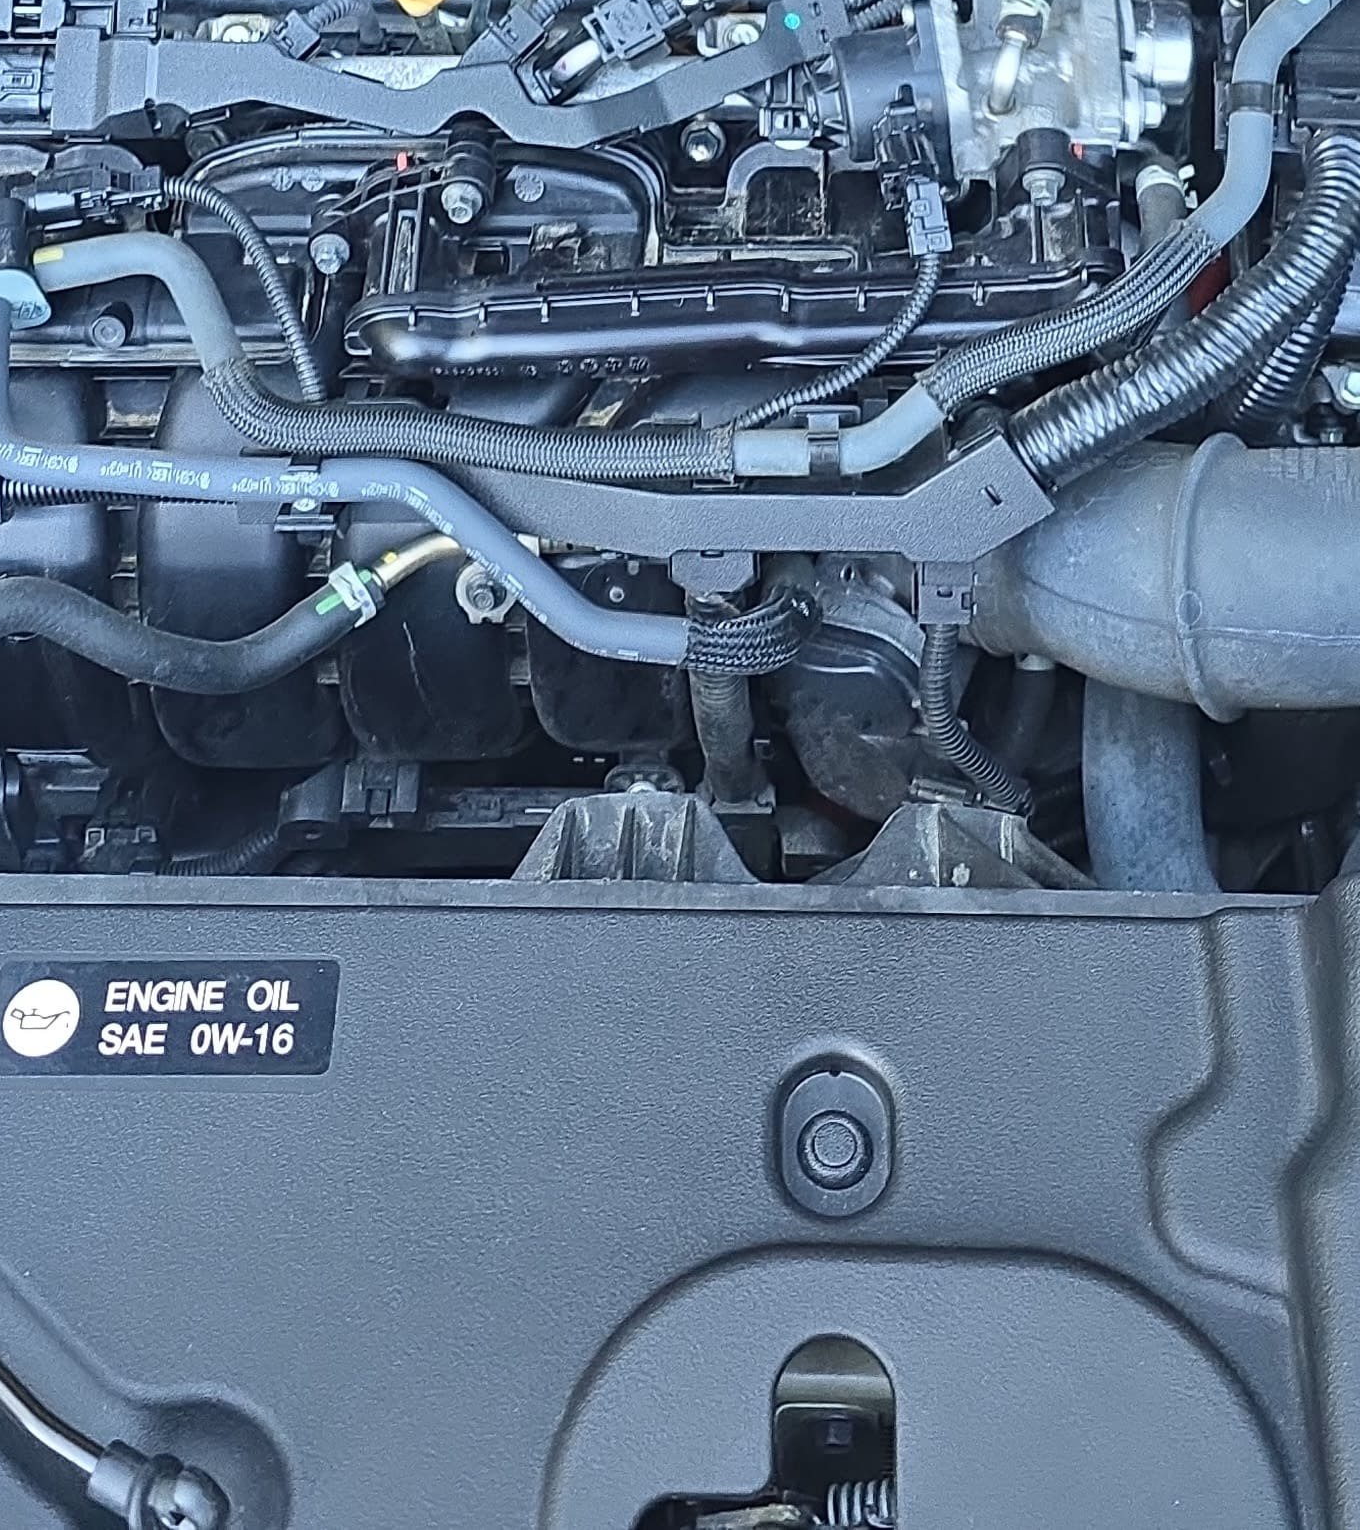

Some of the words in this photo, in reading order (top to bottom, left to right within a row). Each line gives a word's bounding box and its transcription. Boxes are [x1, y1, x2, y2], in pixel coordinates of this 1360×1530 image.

[104, 980, 227, 1012] ENGINE
[246, 980, 300, 1012] OIL
[97, 1023, 169, 1055] SAE
[189, 1023, 295, 1055] 0W-16
